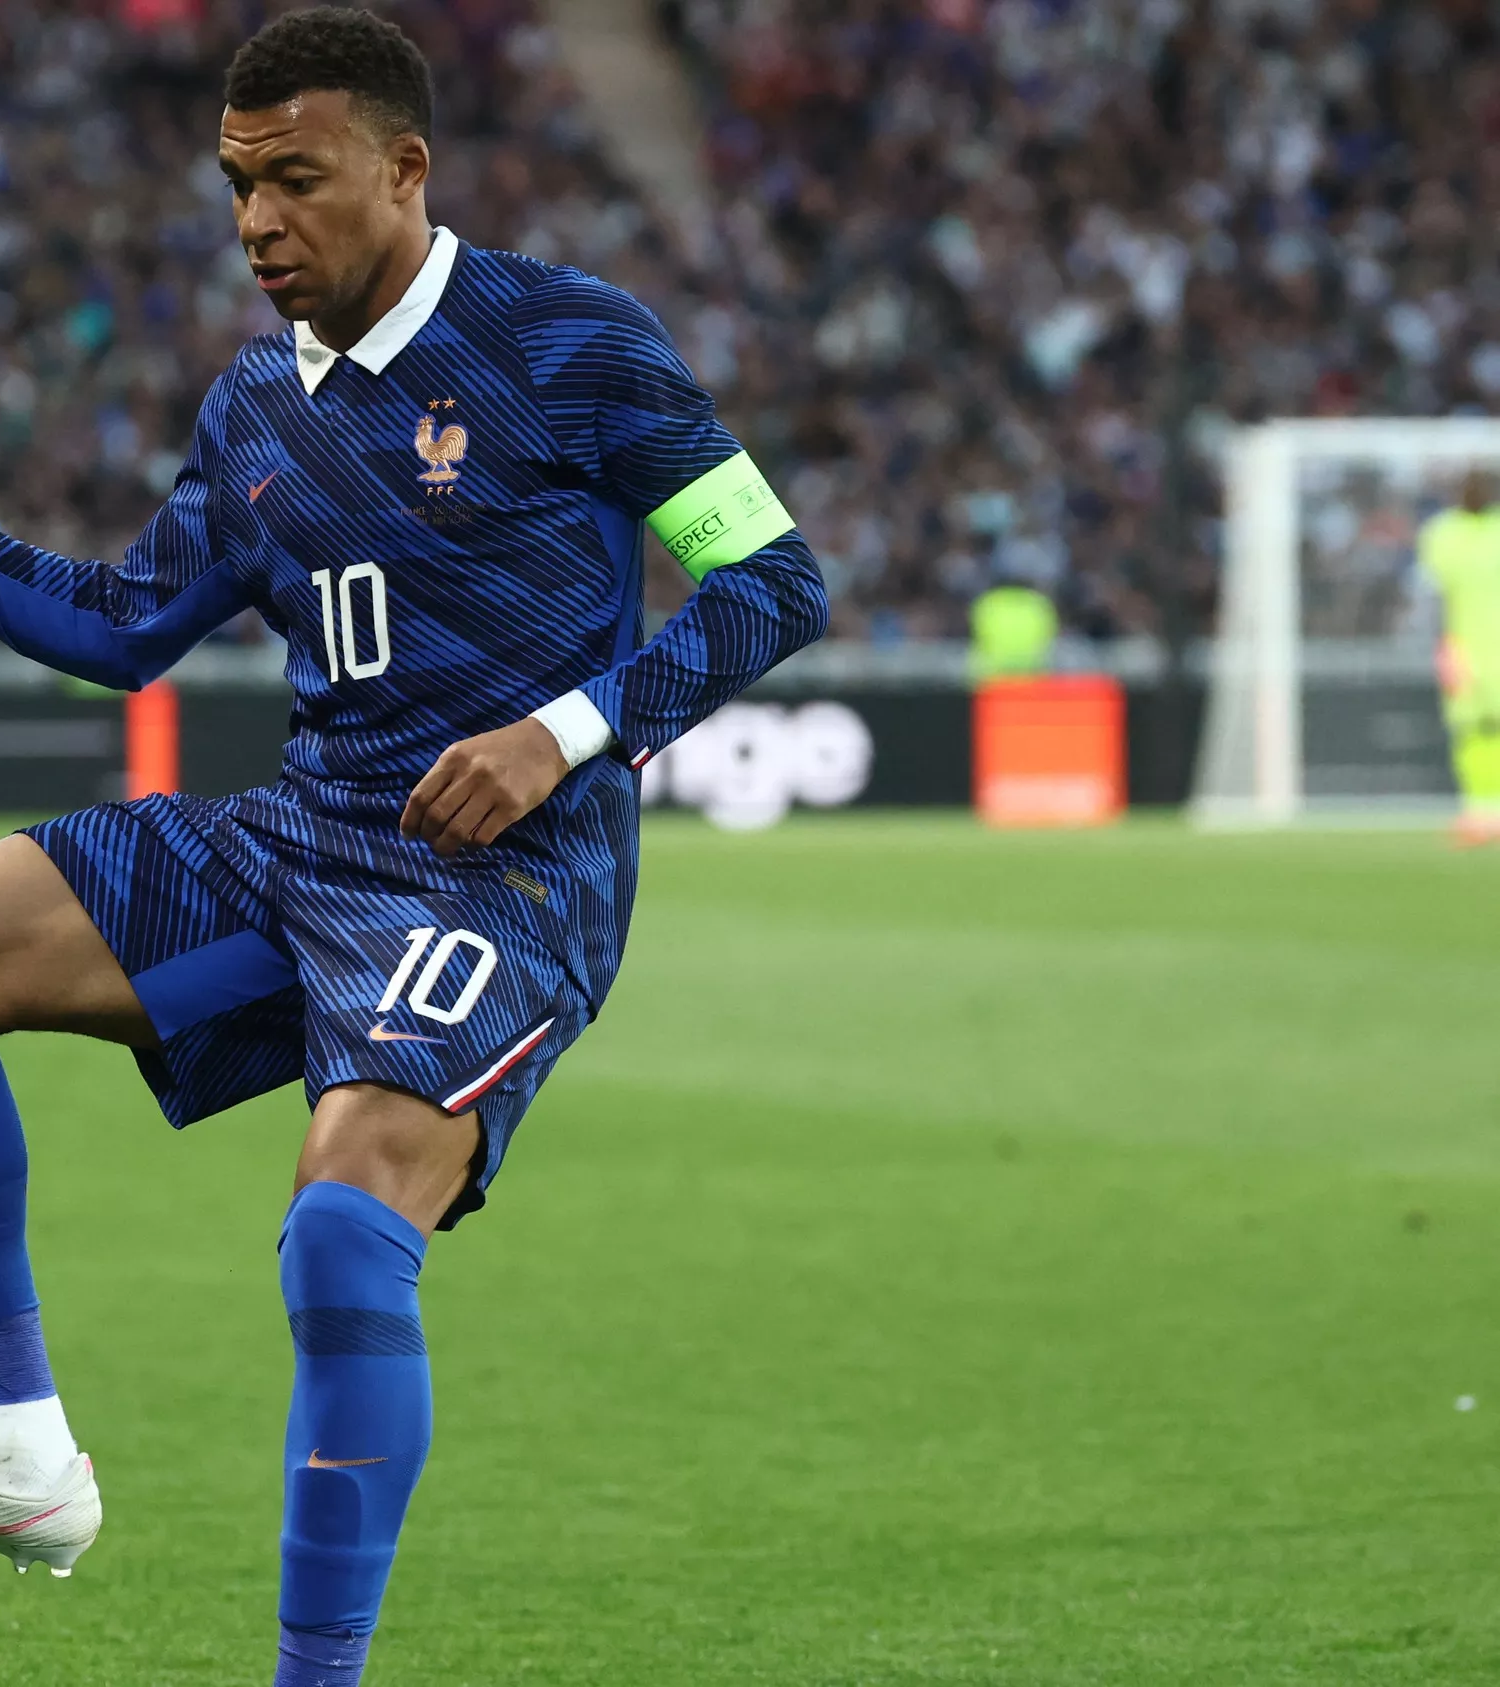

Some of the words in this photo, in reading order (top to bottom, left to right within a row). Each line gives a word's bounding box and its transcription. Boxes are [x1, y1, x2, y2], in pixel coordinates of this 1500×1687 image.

[426, 486, 455, 497] FFF
[668, 511, 724, 560] ESPECT
[311, 561, 391, 683] 10
[640, 701, 875, 832] nge
[375, 926, 498, 1026] 10
